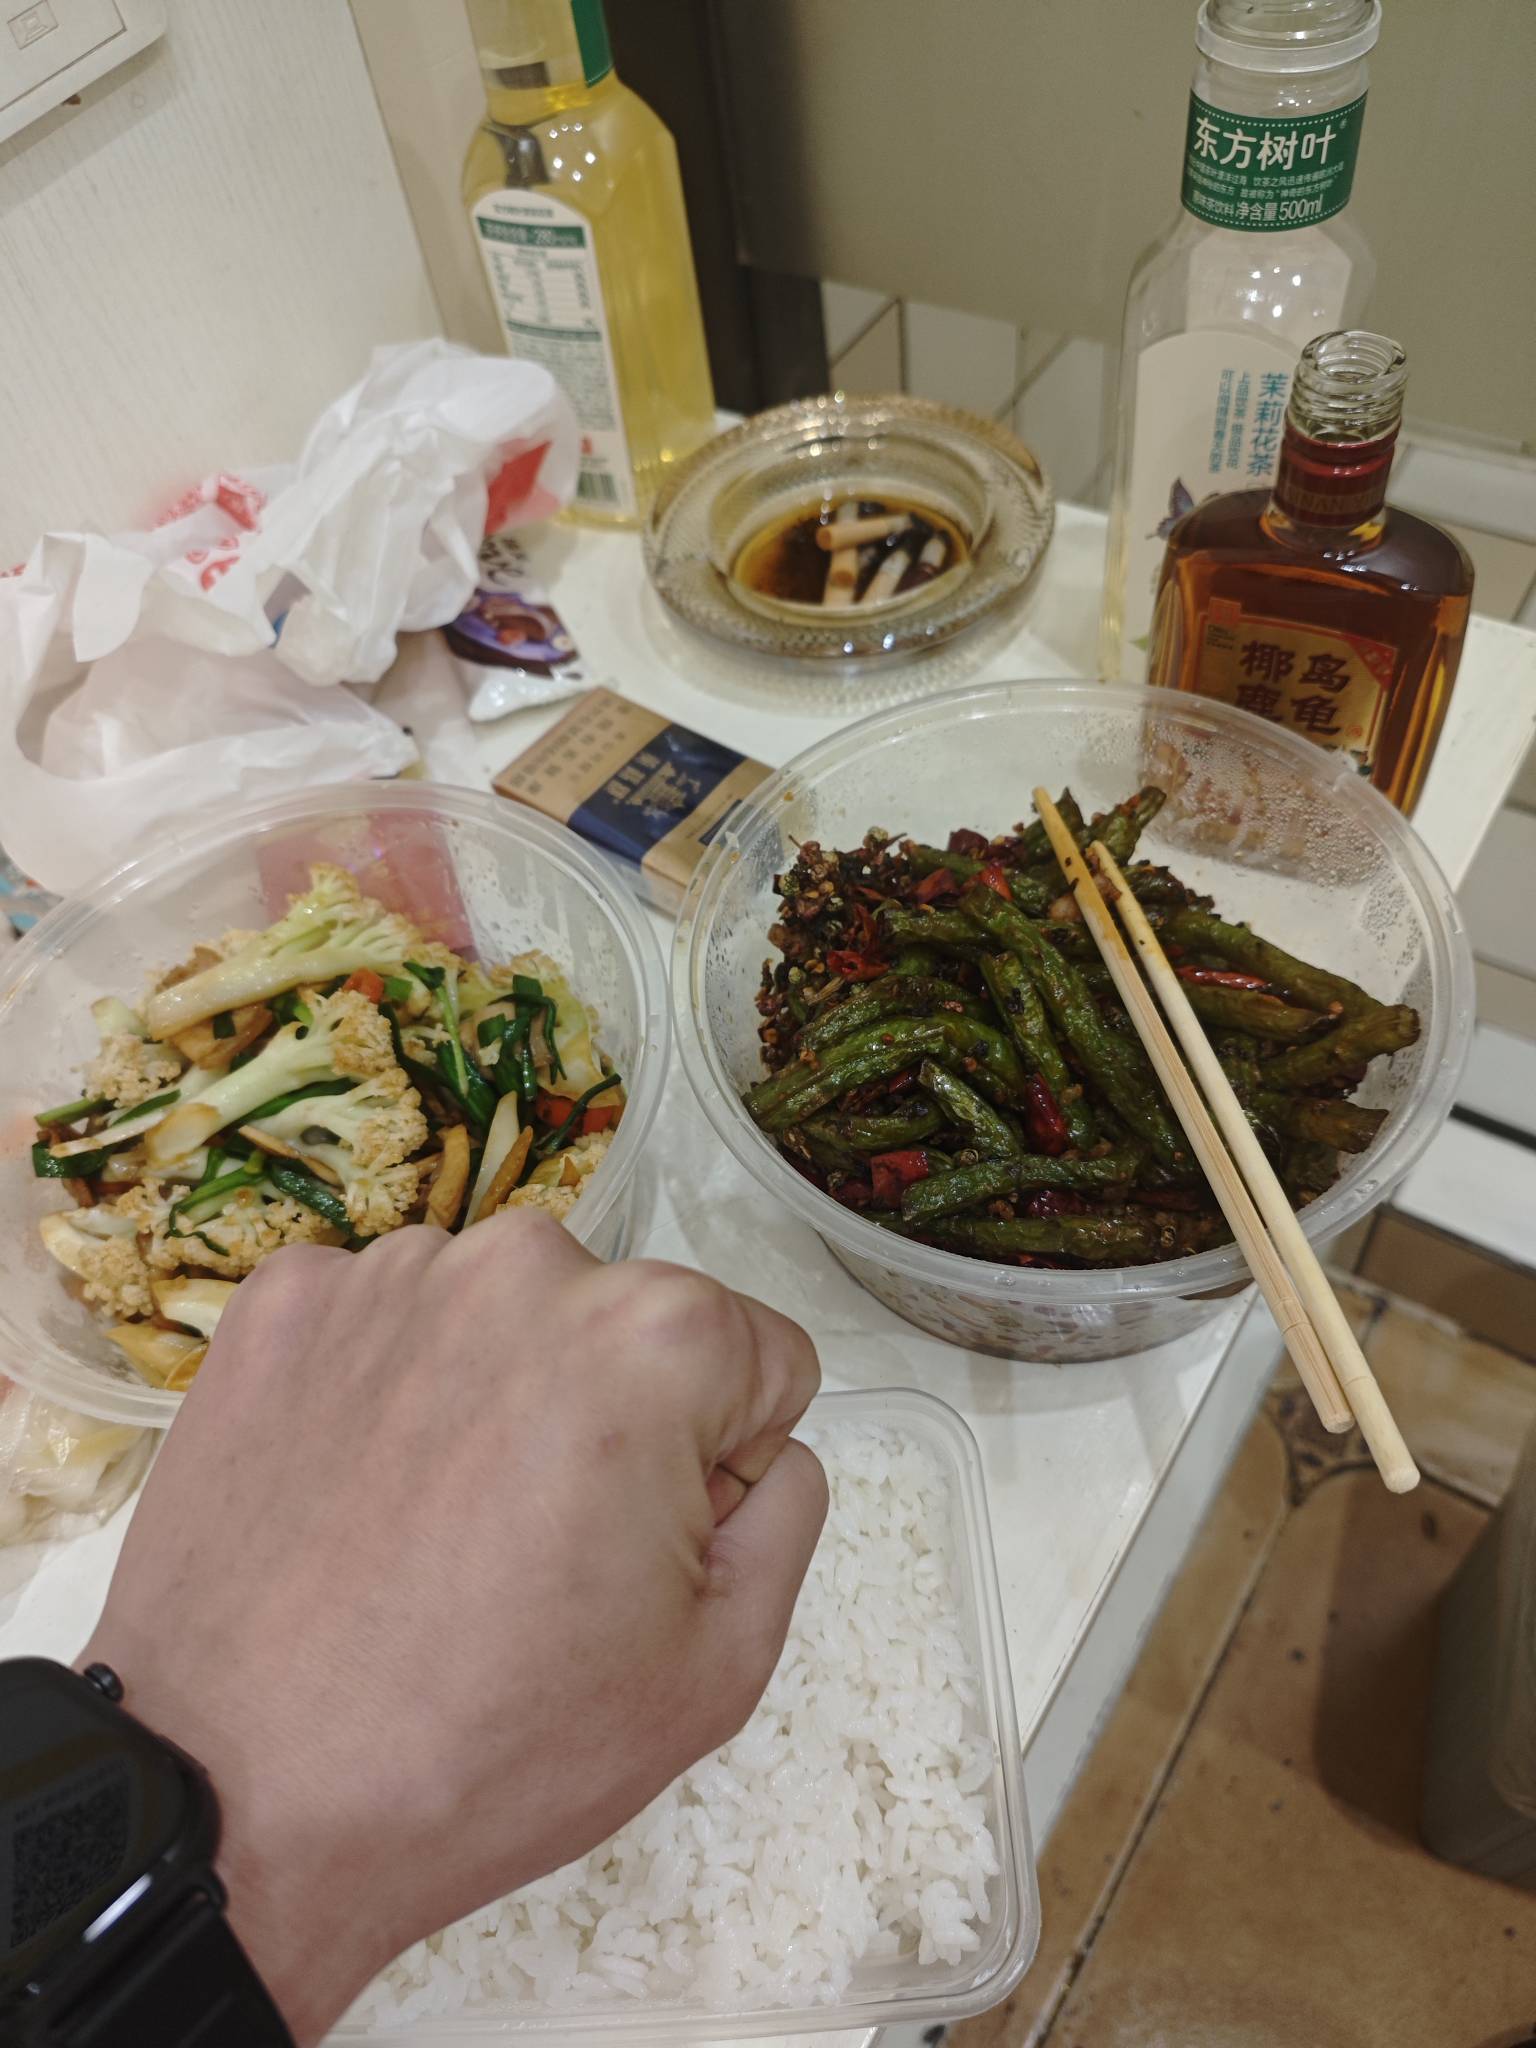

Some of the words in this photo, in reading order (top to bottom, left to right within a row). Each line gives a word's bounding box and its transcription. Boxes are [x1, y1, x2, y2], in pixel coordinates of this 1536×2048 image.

[1194, 117, 1337, 171] 东方树叶
[1247, 373, 1289, 476] 茉莉花茶
[1239, 640, 1350, 693] 椰岛
